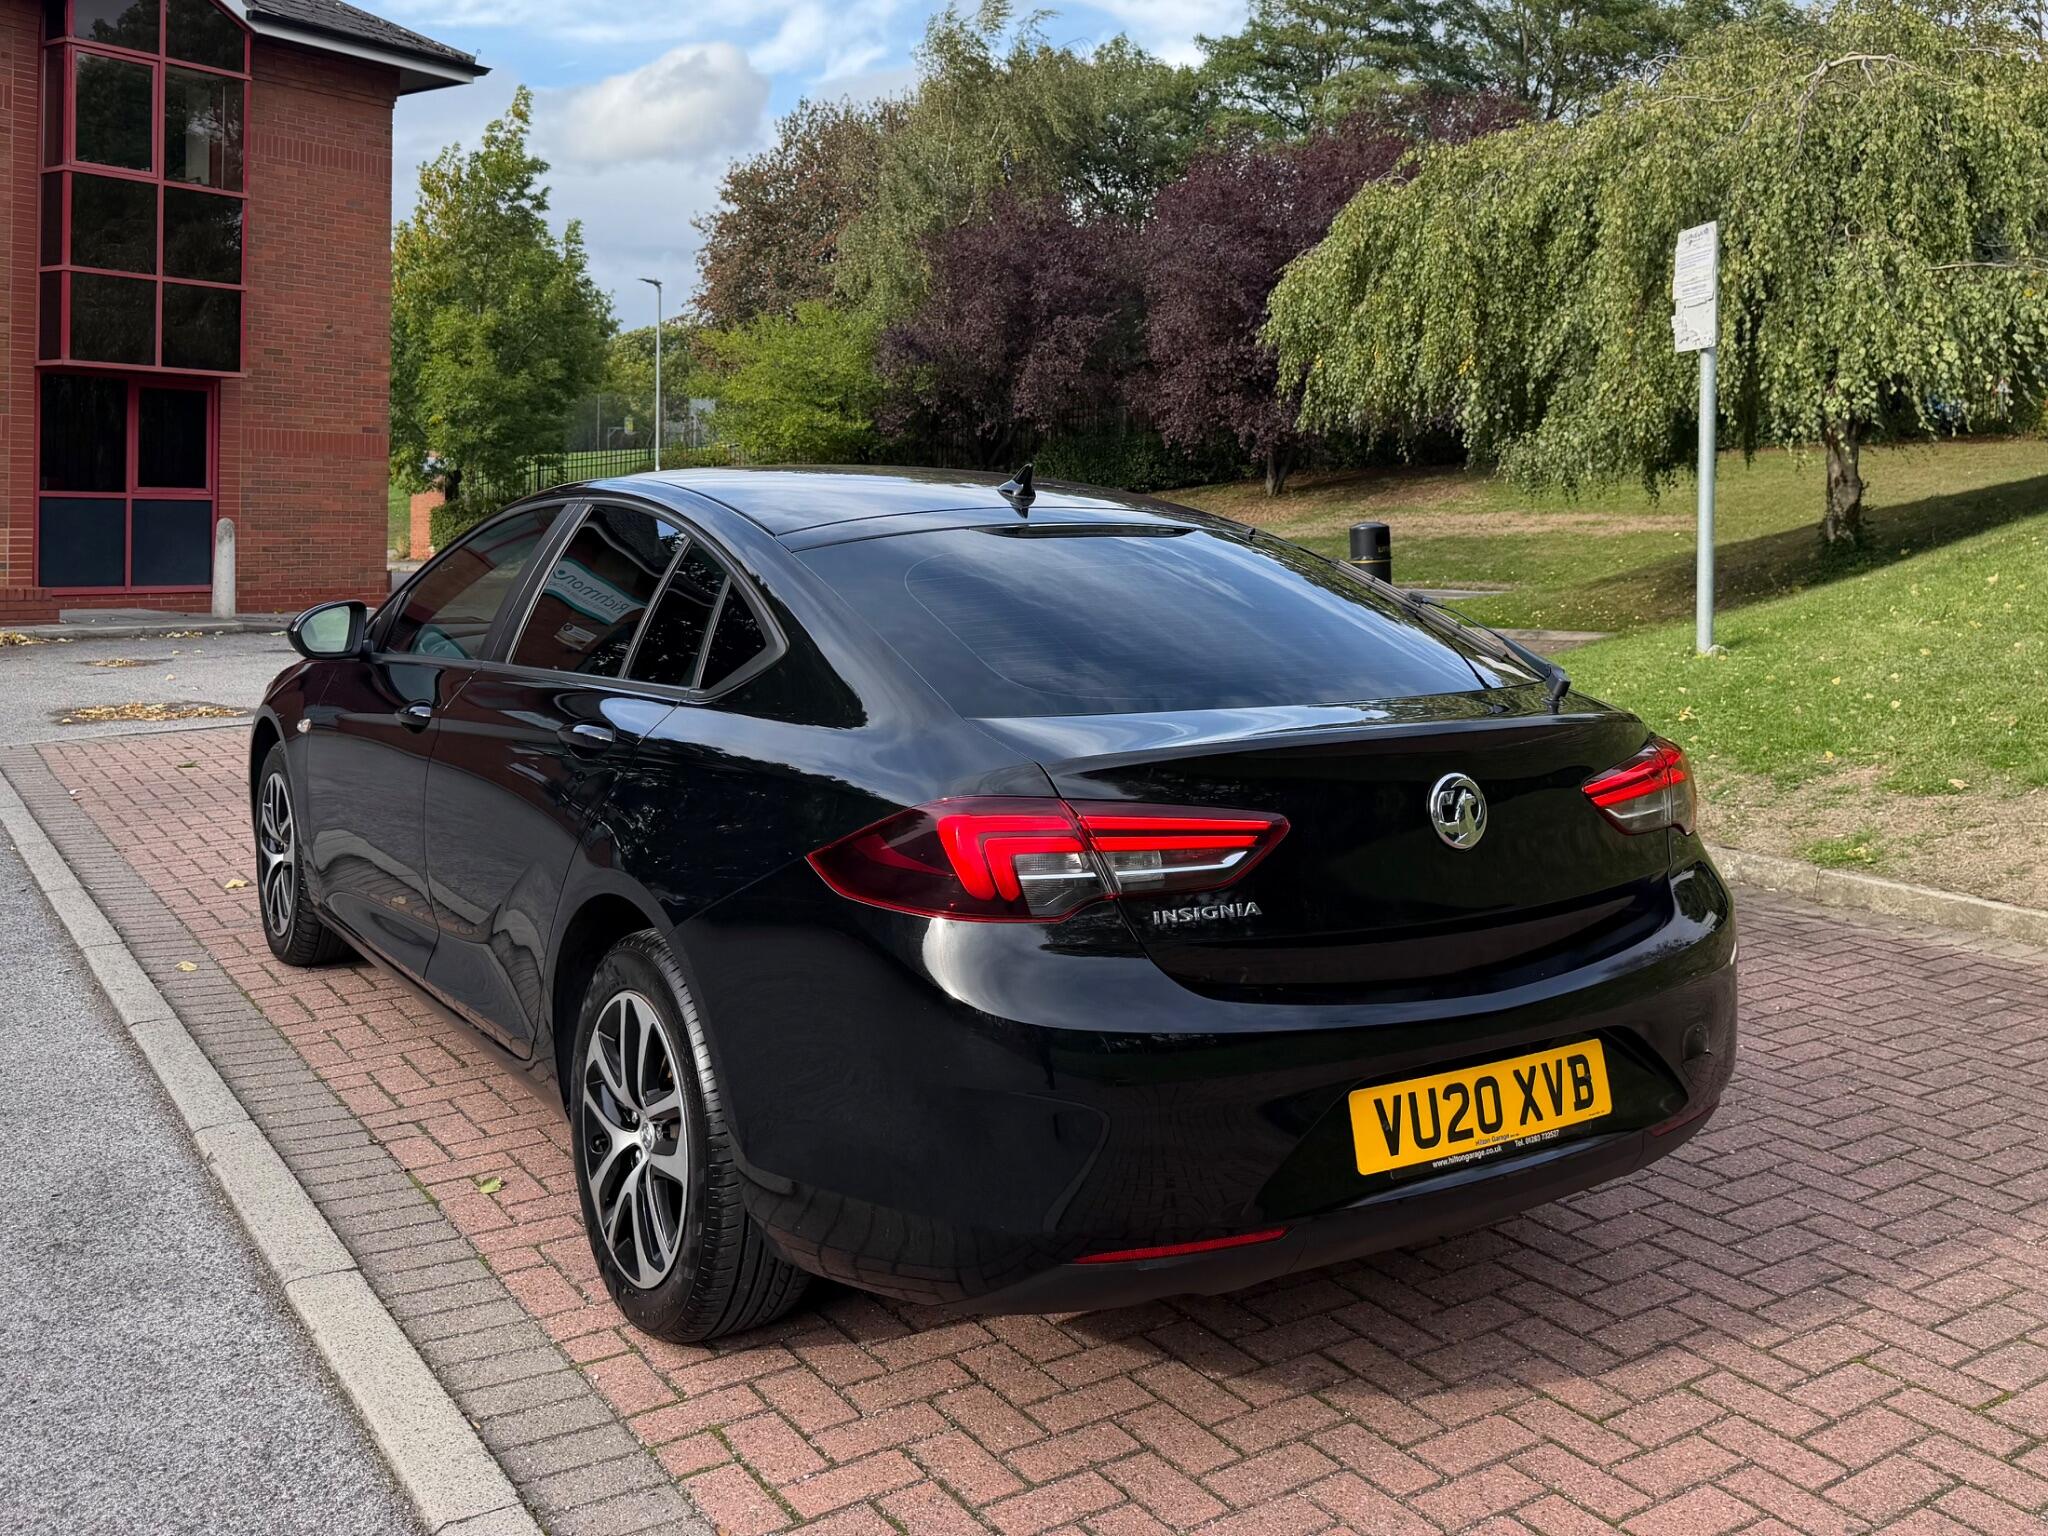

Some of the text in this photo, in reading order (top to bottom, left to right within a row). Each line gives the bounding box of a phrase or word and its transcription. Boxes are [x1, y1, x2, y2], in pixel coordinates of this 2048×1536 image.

[1152, 901, 1263, 925] INSIGNIA
[1373, 1054, 1595, 1157] VU20 XVB
[1432, 1145, 1502, 1167] www.hiltongarage.co.uk
